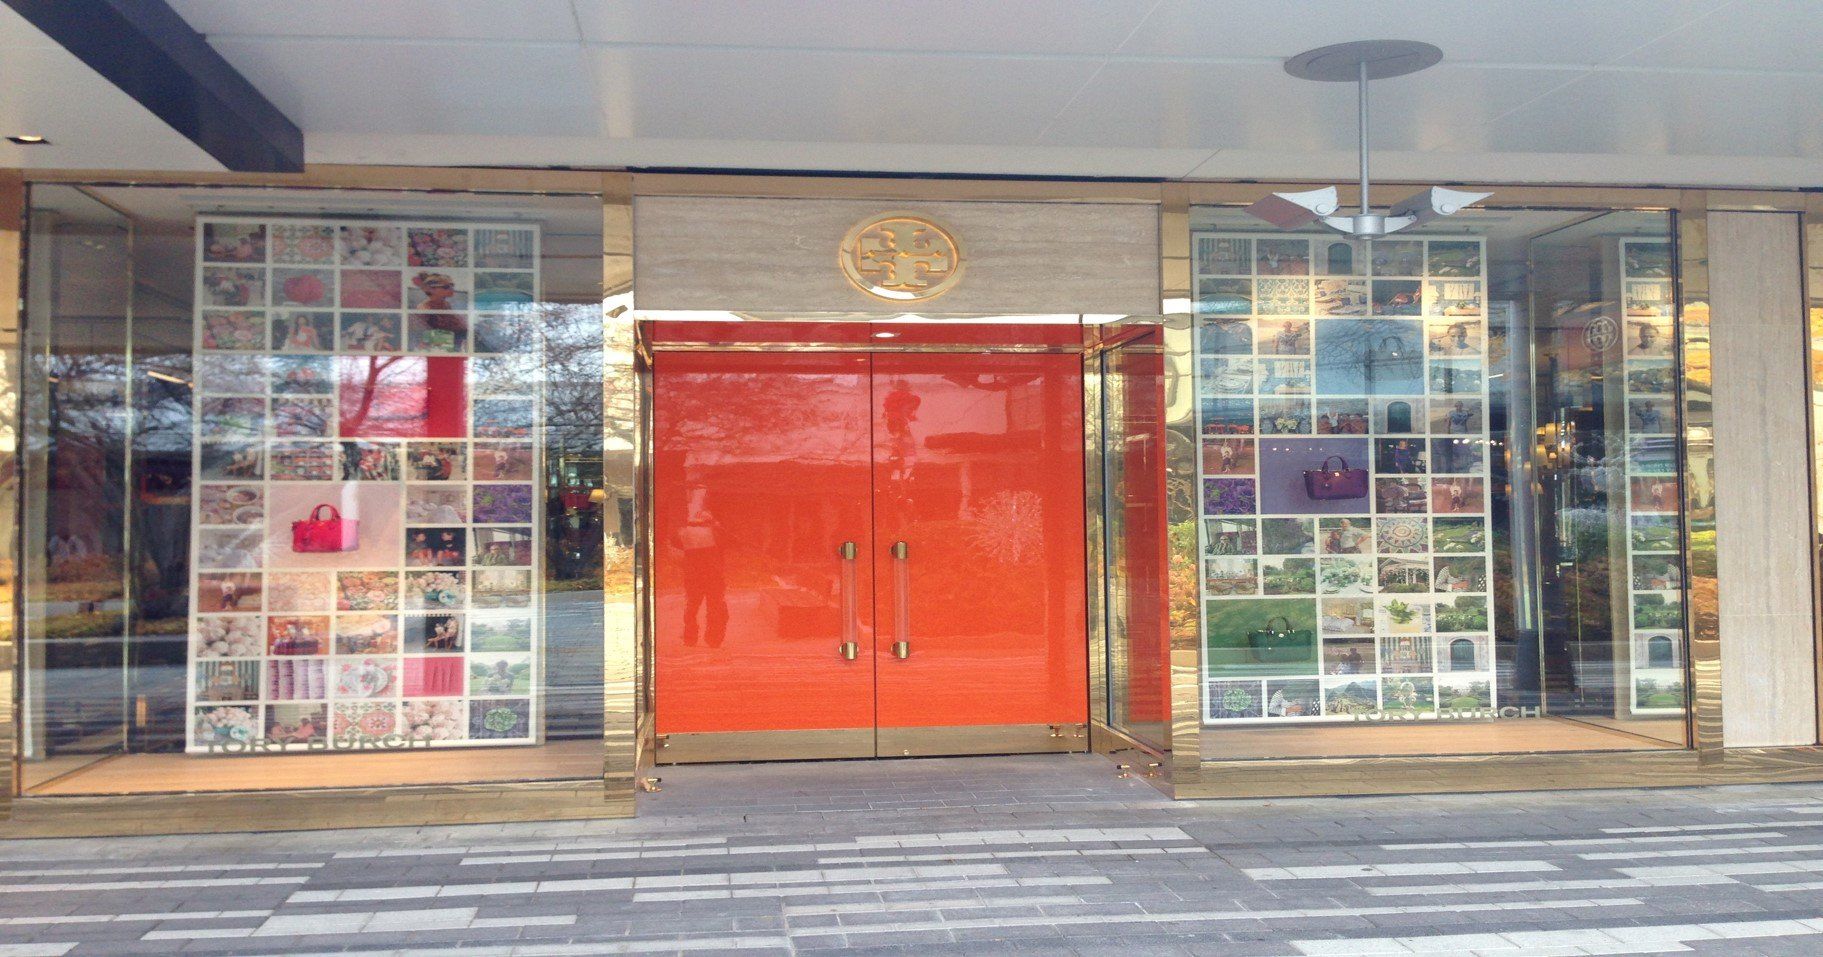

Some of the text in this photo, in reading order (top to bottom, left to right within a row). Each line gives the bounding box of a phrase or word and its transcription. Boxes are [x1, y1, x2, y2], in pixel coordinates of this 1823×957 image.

[1351, 705, 1541, 723] TORY BURCH
[206, 734, 433, 754] TORY BURCH
